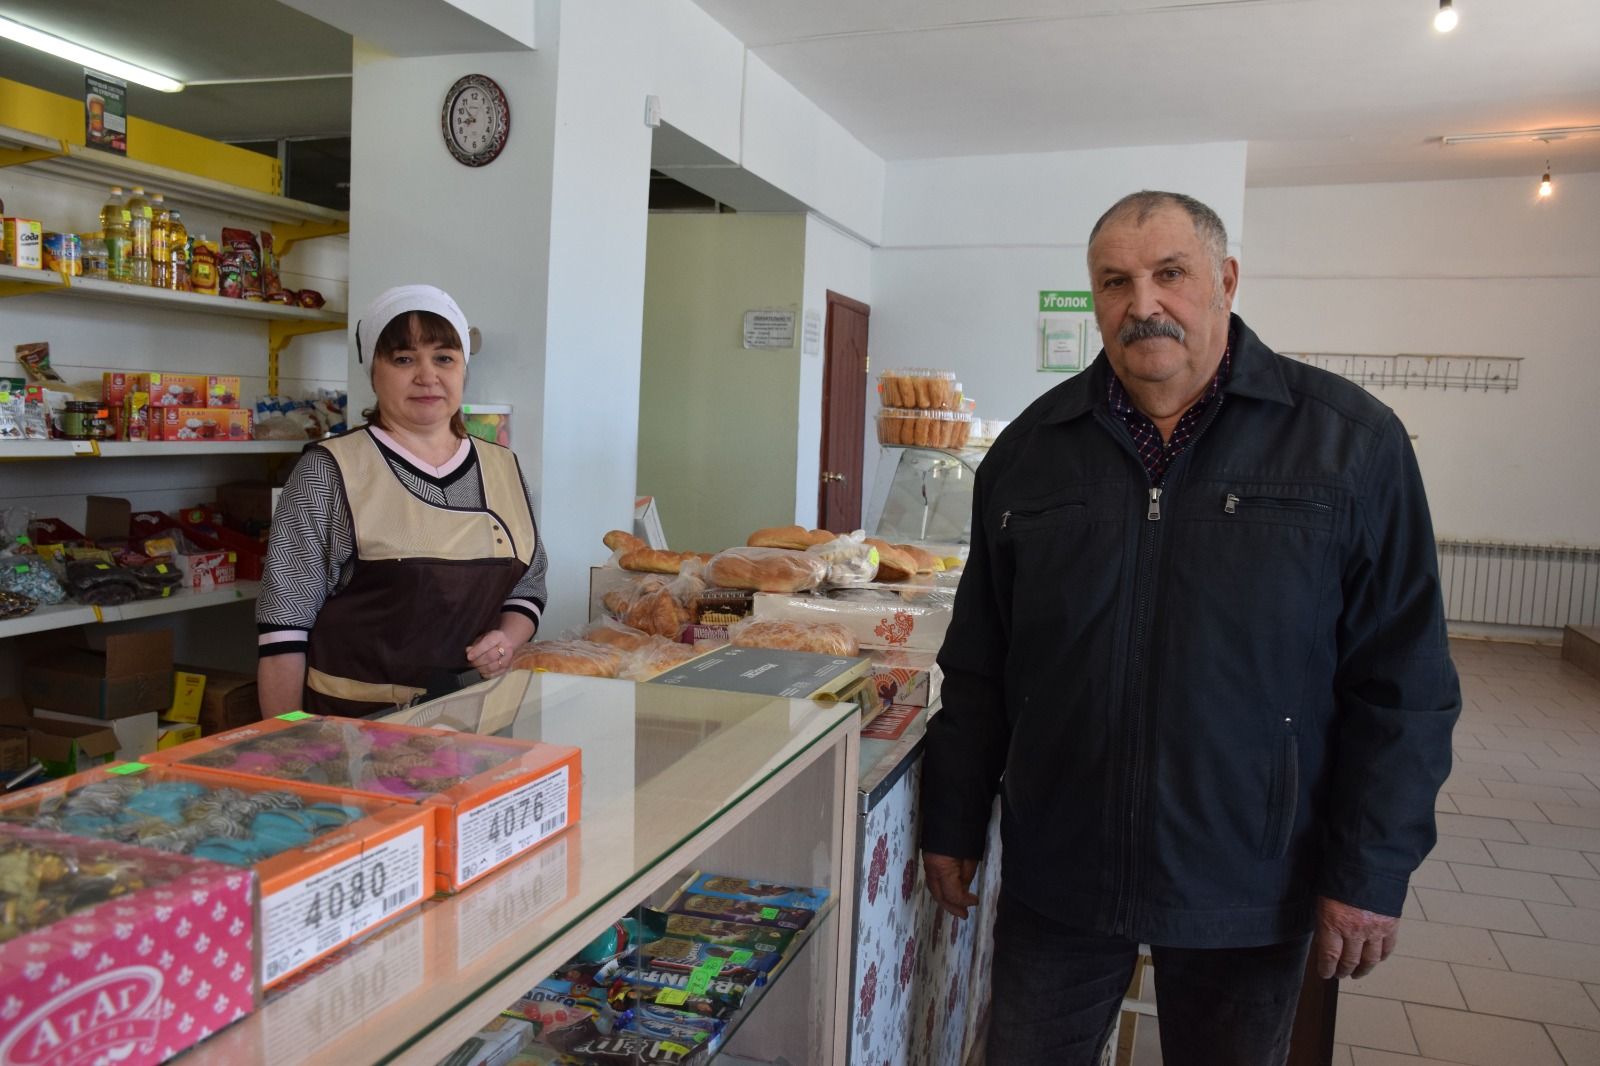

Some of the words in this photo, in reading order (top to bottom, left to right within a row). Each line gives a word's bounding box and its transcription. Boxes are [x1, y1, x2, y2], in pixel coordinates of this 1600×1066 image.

[20, 232, 39, 242] Сода
[488, 791, 554, 844] 4076
[305, 862, 386, 929] 4080
[622, 968, 733, 994] BUNTY
